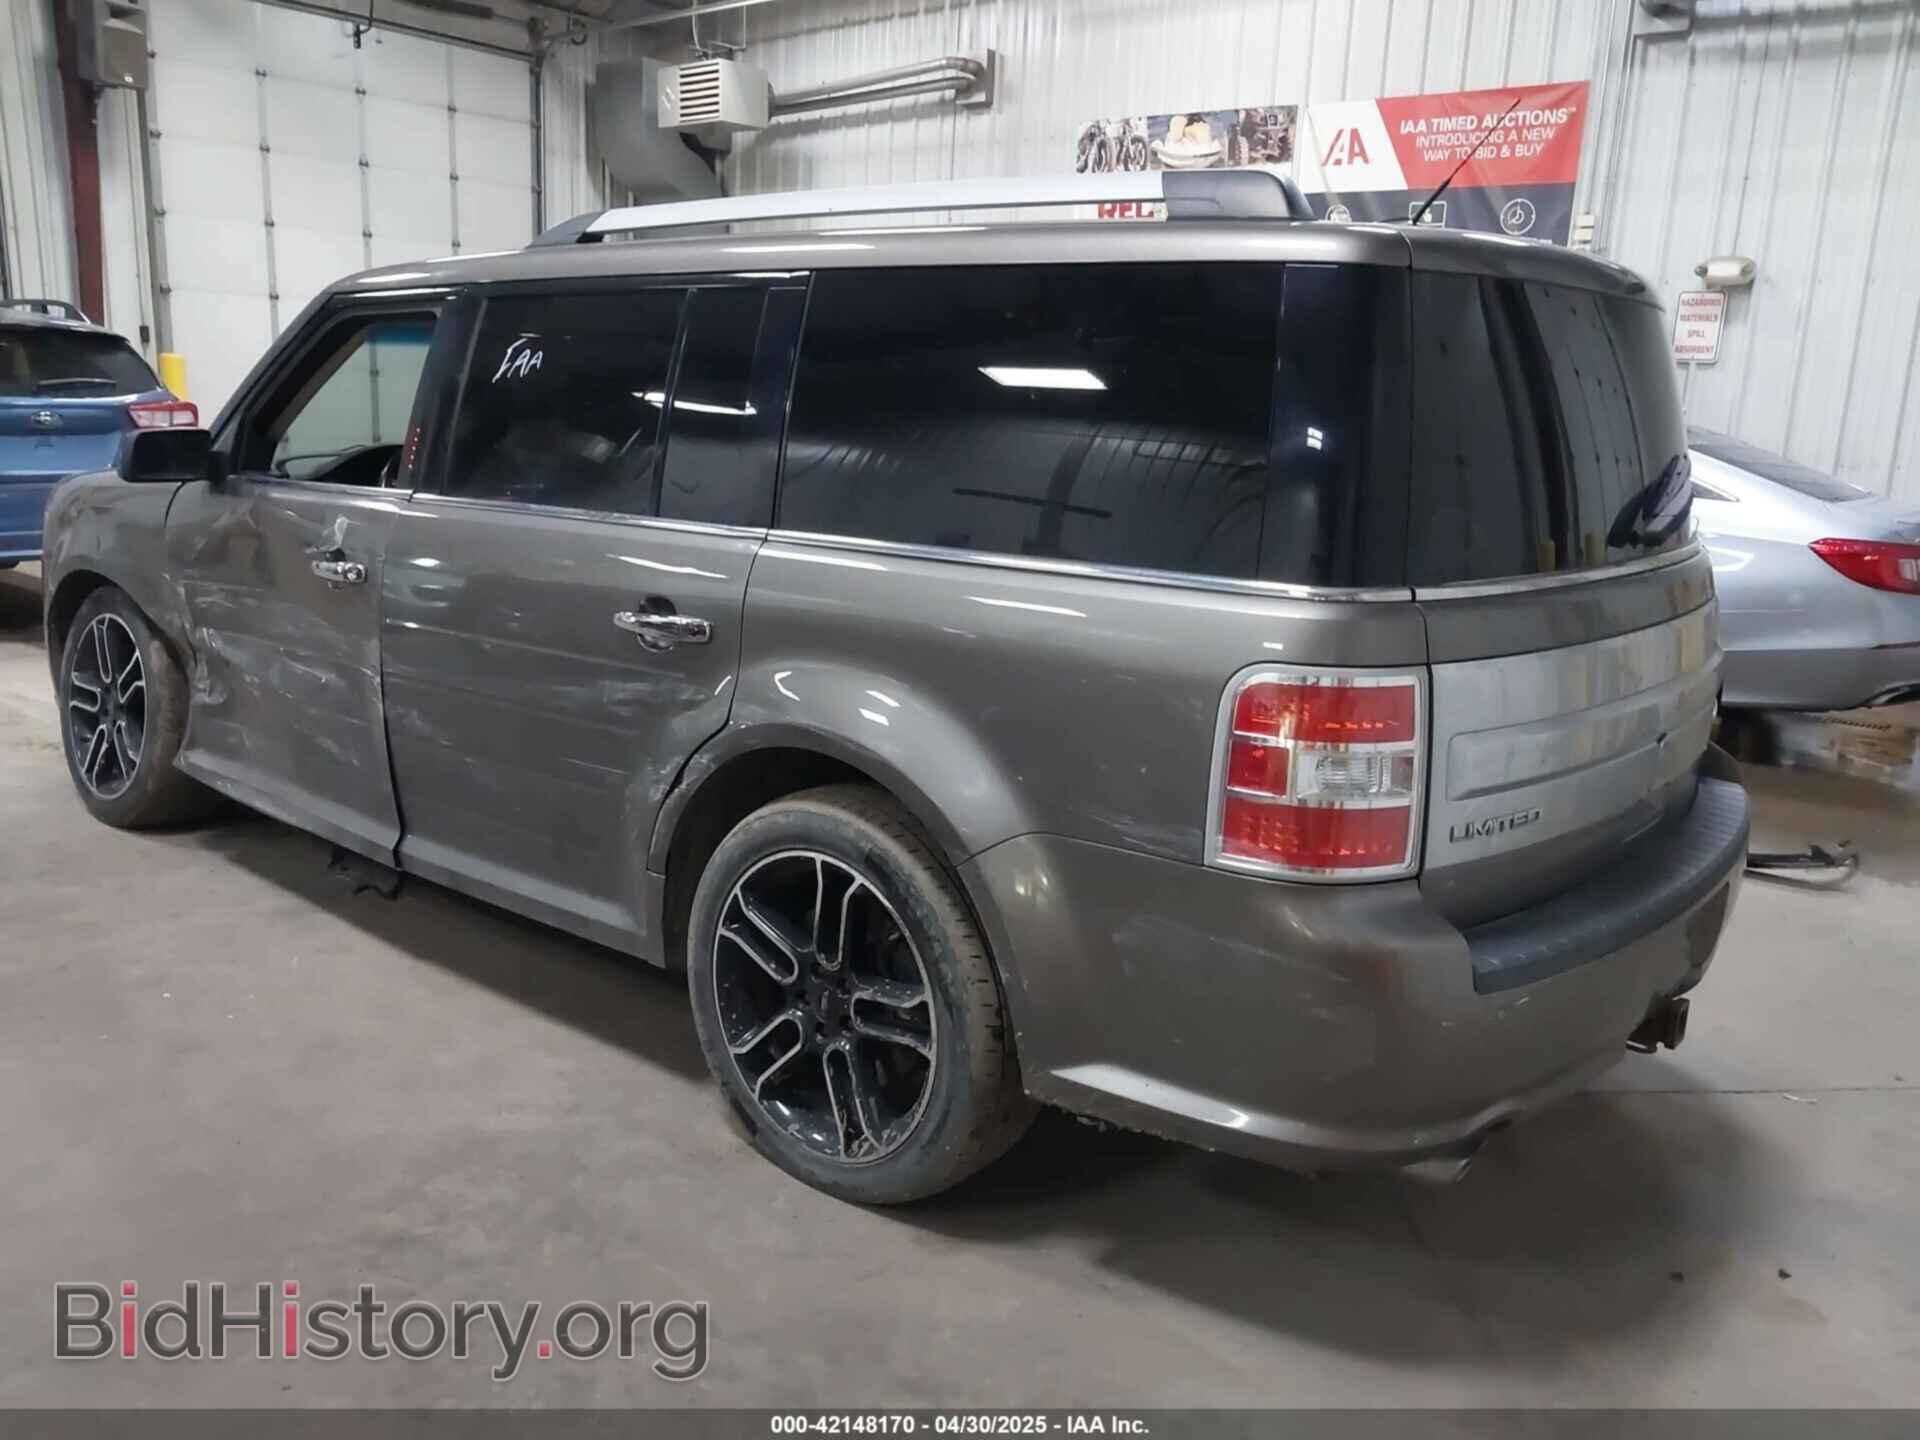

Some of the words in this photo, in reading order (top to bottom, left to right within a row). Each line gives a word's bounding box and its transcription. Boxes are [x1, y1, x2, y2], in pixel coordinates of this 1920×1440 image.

[1400, 119, 1427, 134] IAA
[1431, 115, 1477, 132] TIMED
[1416, 131, 1504, 148] INTRODUCING
[1508, 130, 1519, 142] A
[1522, 127, 1557, 141] NEW
[1423, 148, 1452, 162] WAY
[1455, 147, 1471, 160] TO
[1475, 146, 1497, 158] BID
[1500, 145, 1511, 157] &
[1515, 143, 1544, 157] BUY
[1449, 808, 1542, 843] LIMITED
